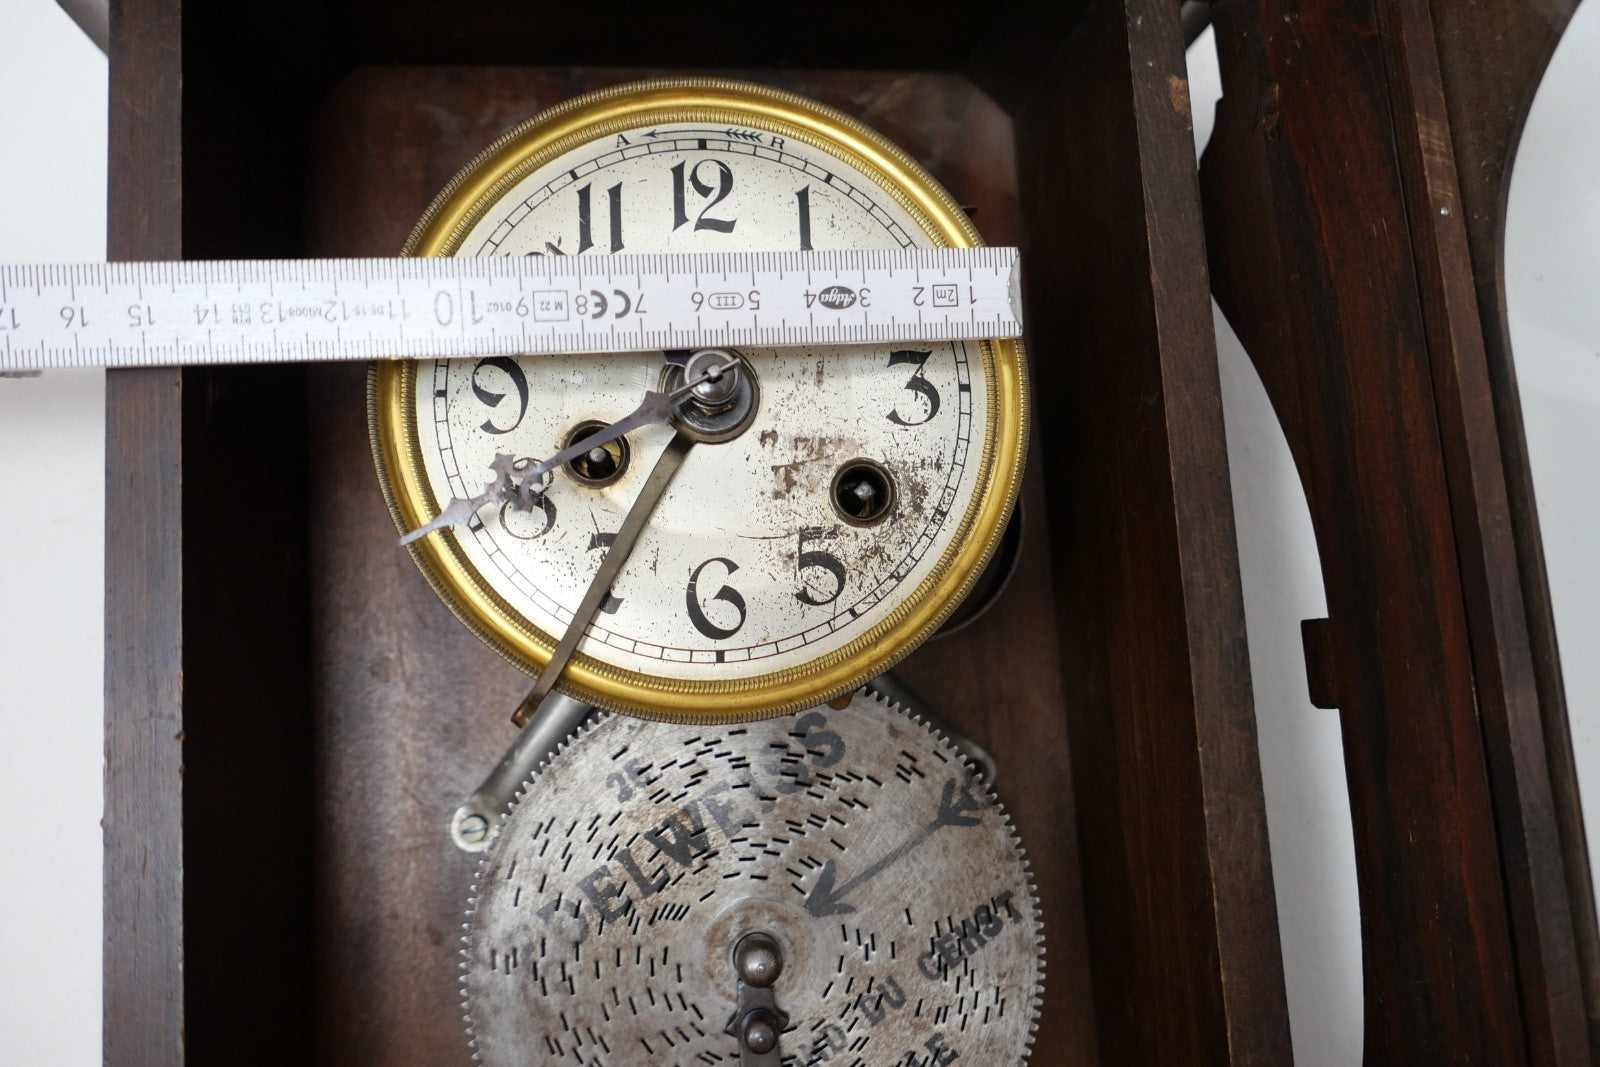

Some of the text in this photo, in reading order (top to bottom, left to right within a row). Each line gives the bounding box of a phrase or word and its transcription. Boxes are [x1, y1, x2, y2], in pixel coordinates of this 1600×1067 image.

[615, 133, 631, 147] A
[770, 136, 785, 149] R
[670, 158, 737, 233] 12
[576, 181, 625, 255] 11
[795, 184, 814, 250] 1
[575, 294, 588, 315] 8
[635, 293, 647, 313] 7
[691, 291, 704, 312] 6
[748, 290, 760, 310] 5
[804, 289, 817, 309] 4
[860, 287, 871, 307] 3
[913, 286, 925, 306] 2
[936, 289, 954, 302] 2m
[969, 285, 977, 305] 1
[60, 306, 89, 329] 16
[128, 304, 155, 328] 15
[194, 303, 223, 326] 14
[260, 302, 286, 324] 13
[324, 300, 351, 323] 12
[516, 297, 529, 317] 9
[472, 356, 529, 435] 9
[886, 350, 941, 426] 3
[794, 524, 846, 606] 5
[686, 557, 747, 640] 6
